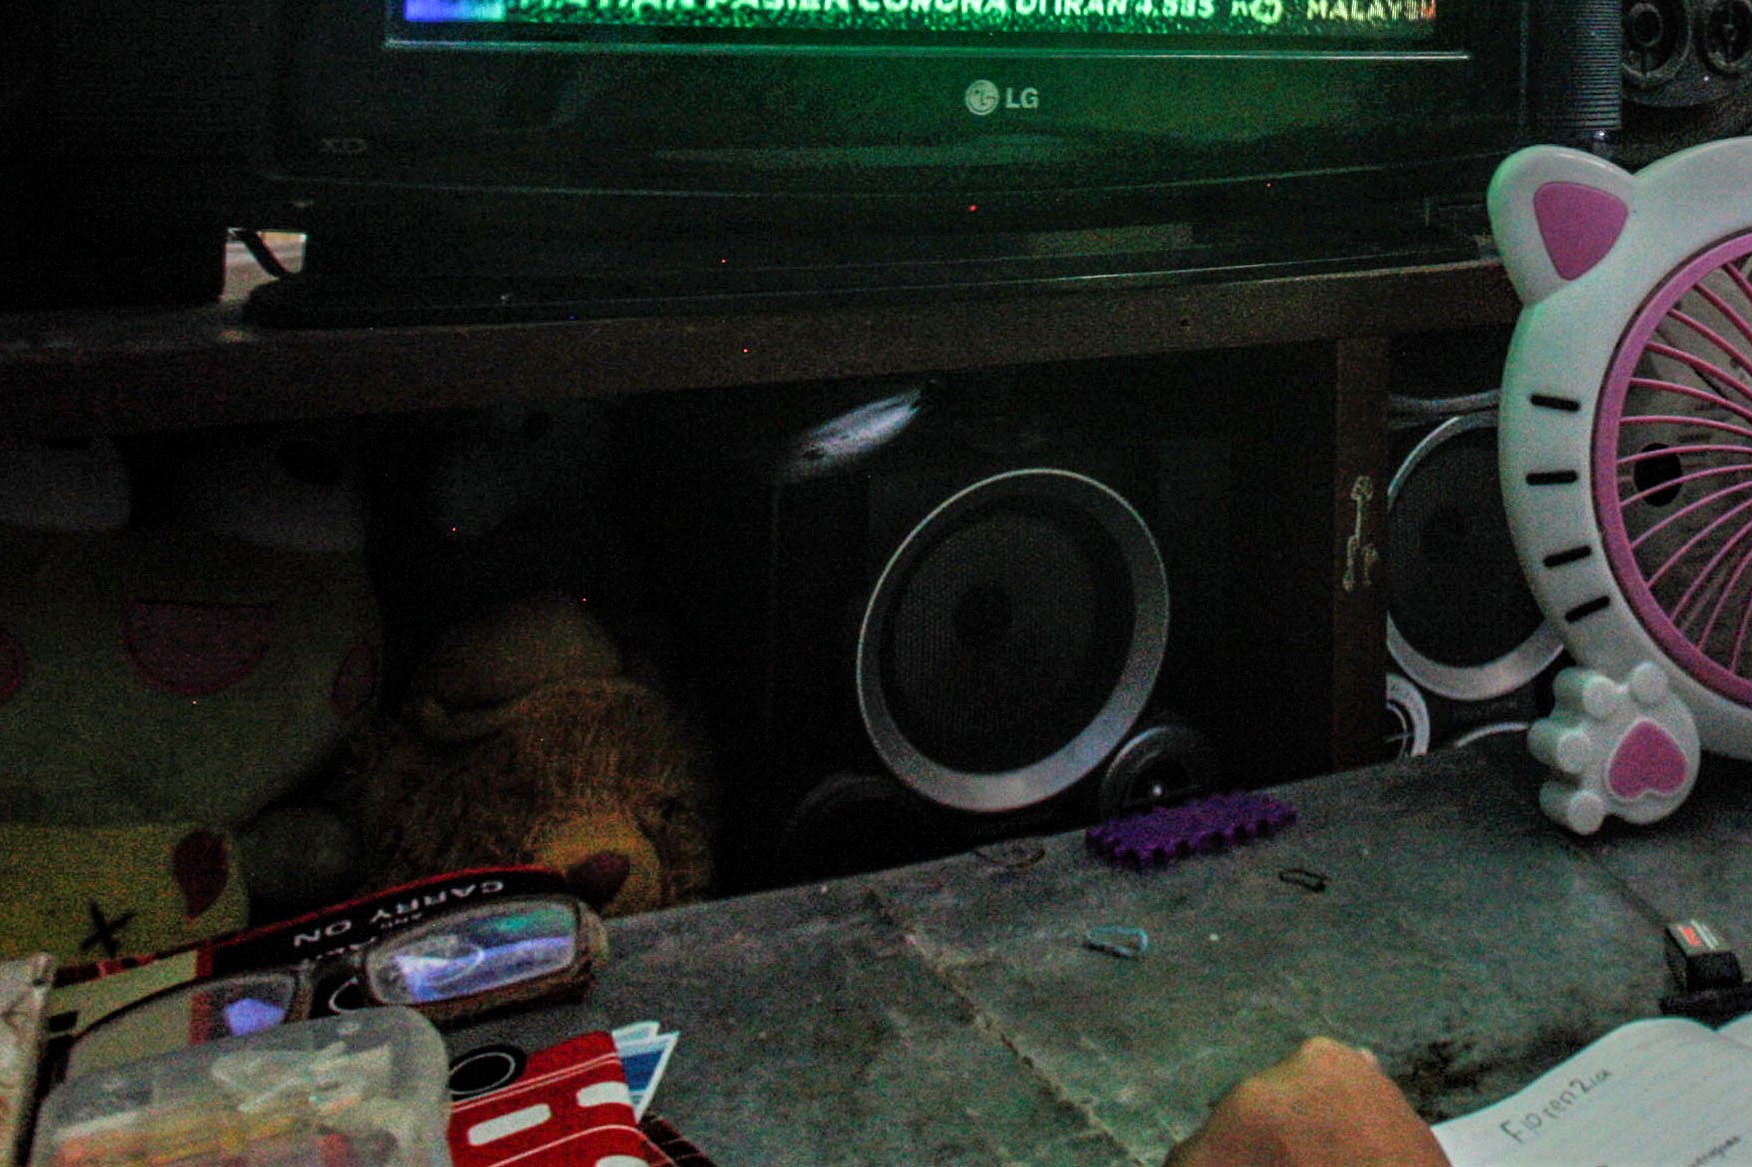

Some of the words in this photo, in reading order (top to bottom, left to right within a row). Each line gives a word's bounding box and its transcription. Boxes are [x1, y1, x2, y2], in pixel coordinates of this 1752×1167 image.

[1006, 87, 1039, 109] LG
[371, 881, 503, 924] CARRY
[292, 917, 353, 948] ON
